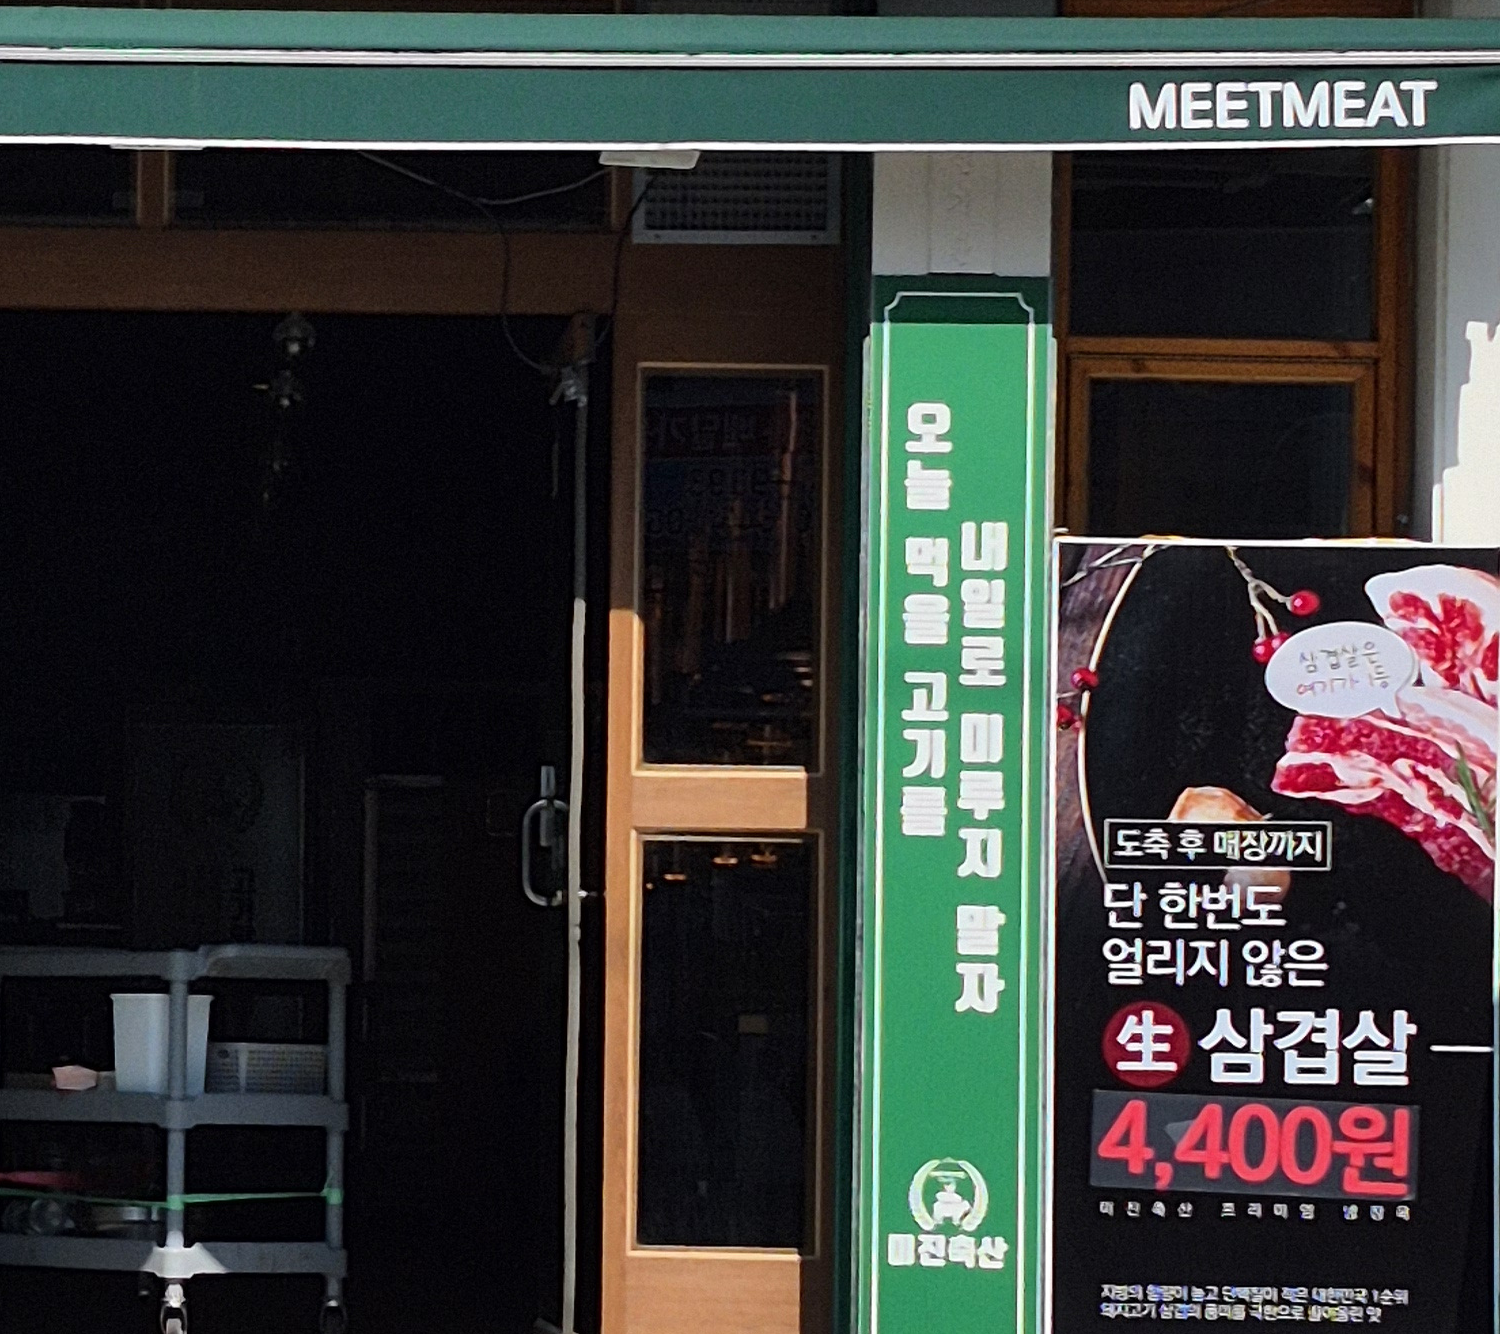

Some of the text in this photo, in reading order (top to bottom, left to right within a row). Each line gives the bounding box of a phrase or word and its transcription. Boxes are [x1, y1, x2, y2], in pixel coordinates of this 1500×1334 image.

[1129, 79, 1439, 131] MEETMEAT
[900, 401, 953, 837] 오늘 먹을 고기를
[1298, 640, 1380, 675] 삼겹살은
[955, 521, 1009, 1014] 내일로 미루지 말자
[1113, 828, 1323, 862] 도축 후 매장까지
[1102, 881, 1288, 930] 단 한번도
[1102, 937, 1330, 988] 얼리지 않은
[1115, 1007, 1419, 1087] 生 삼겹살
[1096, 1098, 1412, 1196] 4,400원
[886, 1231, 1010, 1270] 미진축산
